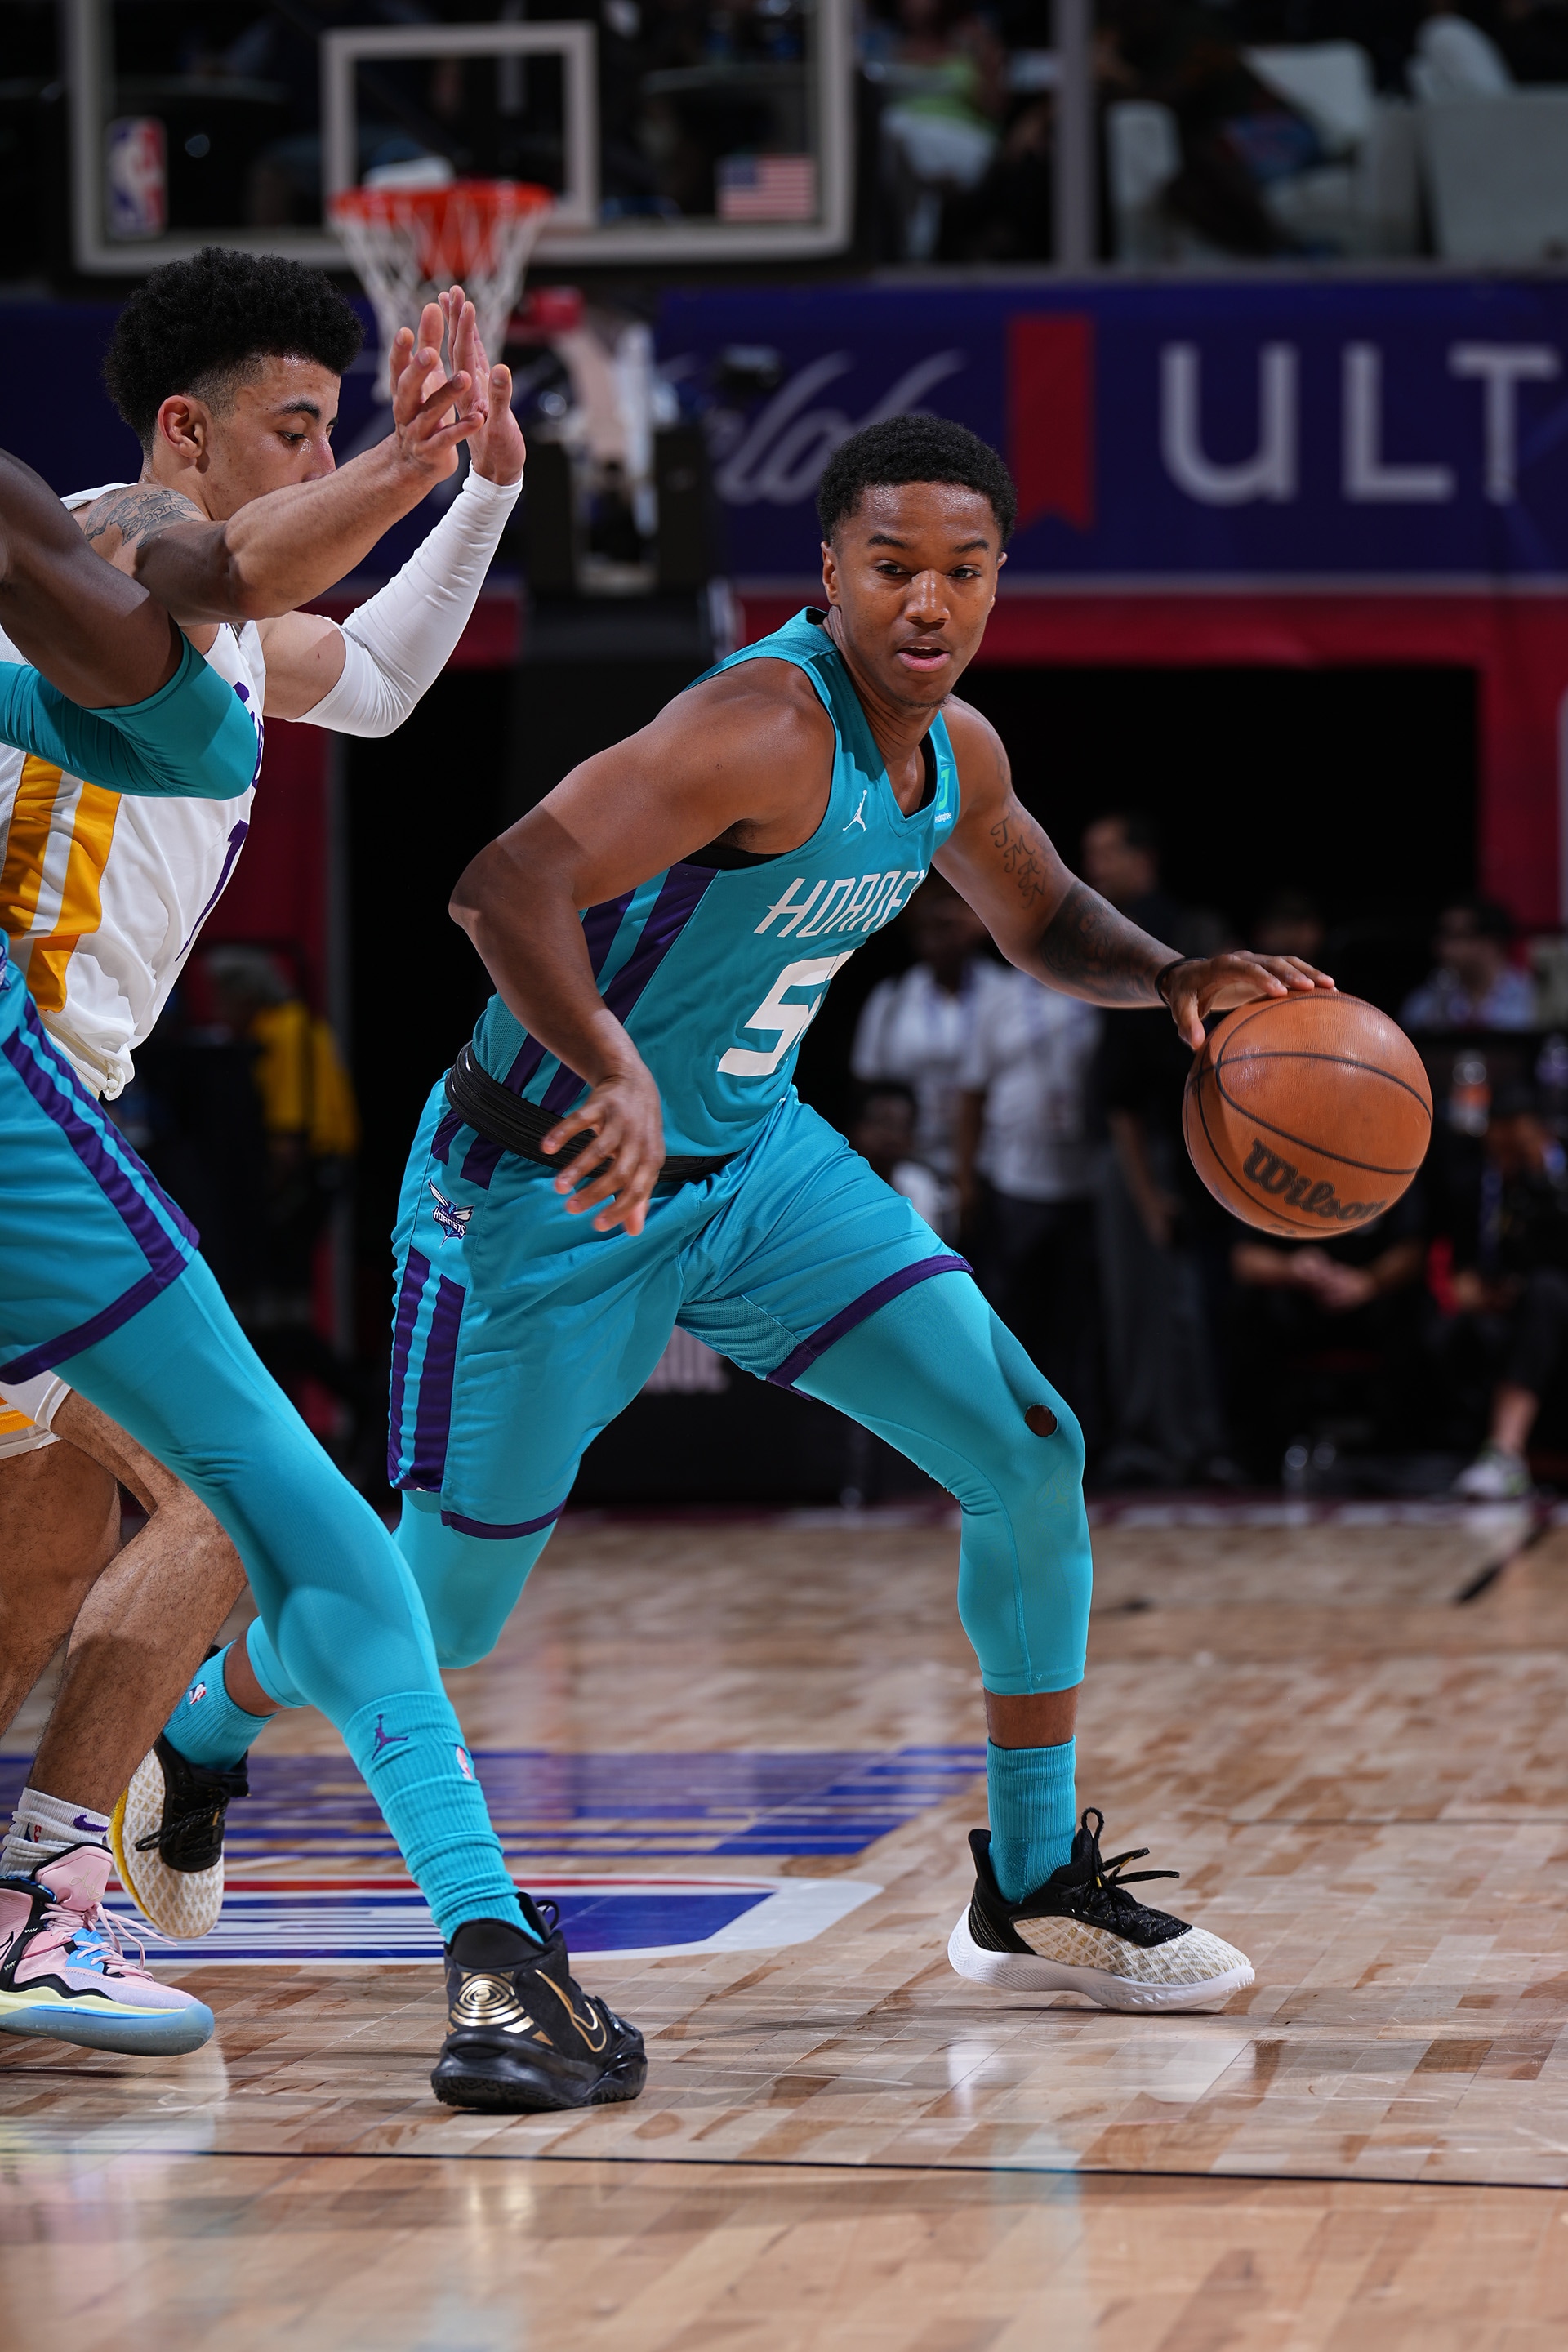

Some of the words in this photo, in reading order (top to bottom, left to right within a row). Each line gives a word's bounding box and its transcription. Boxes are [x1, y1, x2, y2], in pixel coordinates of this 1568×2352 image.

[754, 869, 925, 938] HORNE
[1243, 1138, 1387, 1220] Wilson
[434, 1208, 466, 1236] HORNETS
